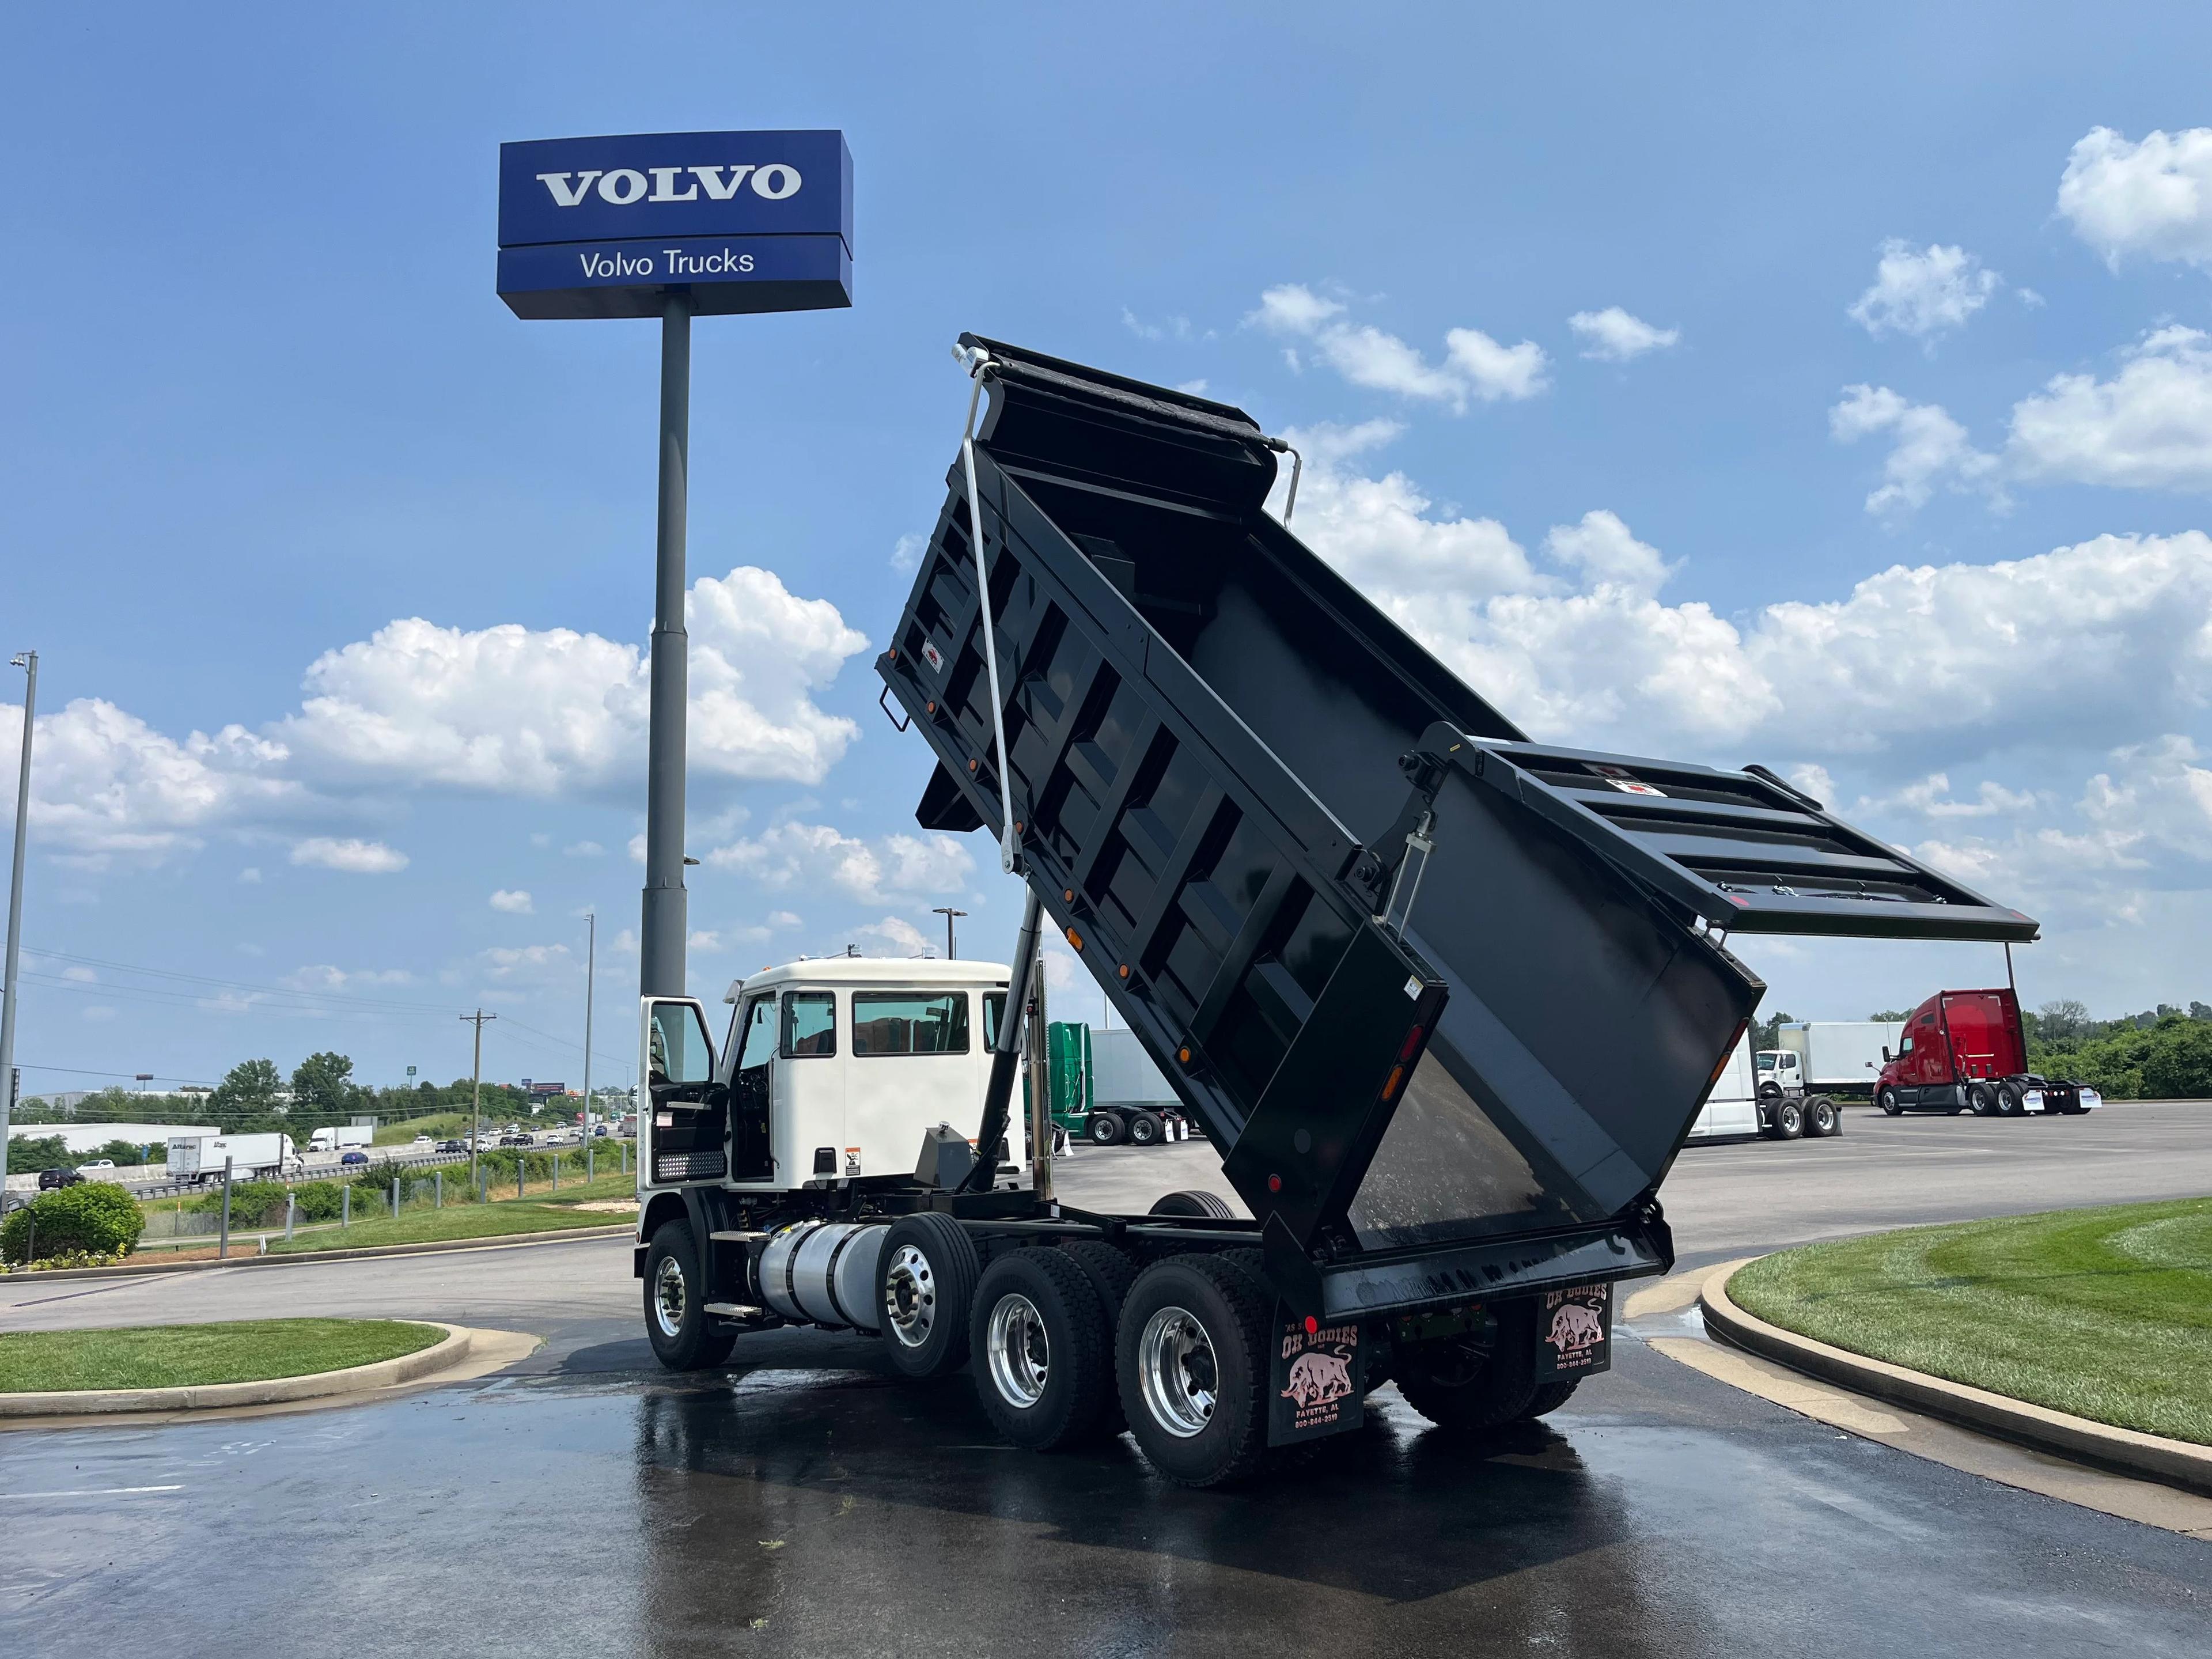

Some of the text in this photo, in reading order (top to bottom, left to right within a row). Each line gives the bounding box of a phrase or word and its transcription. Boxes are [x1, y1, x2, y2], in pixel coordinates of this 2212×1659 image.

[536, 163, 802, 207] VOLVO
[580, 248, 754, 278] Volvo Trucks
[1282, 1334, 1302, 1359] OX
